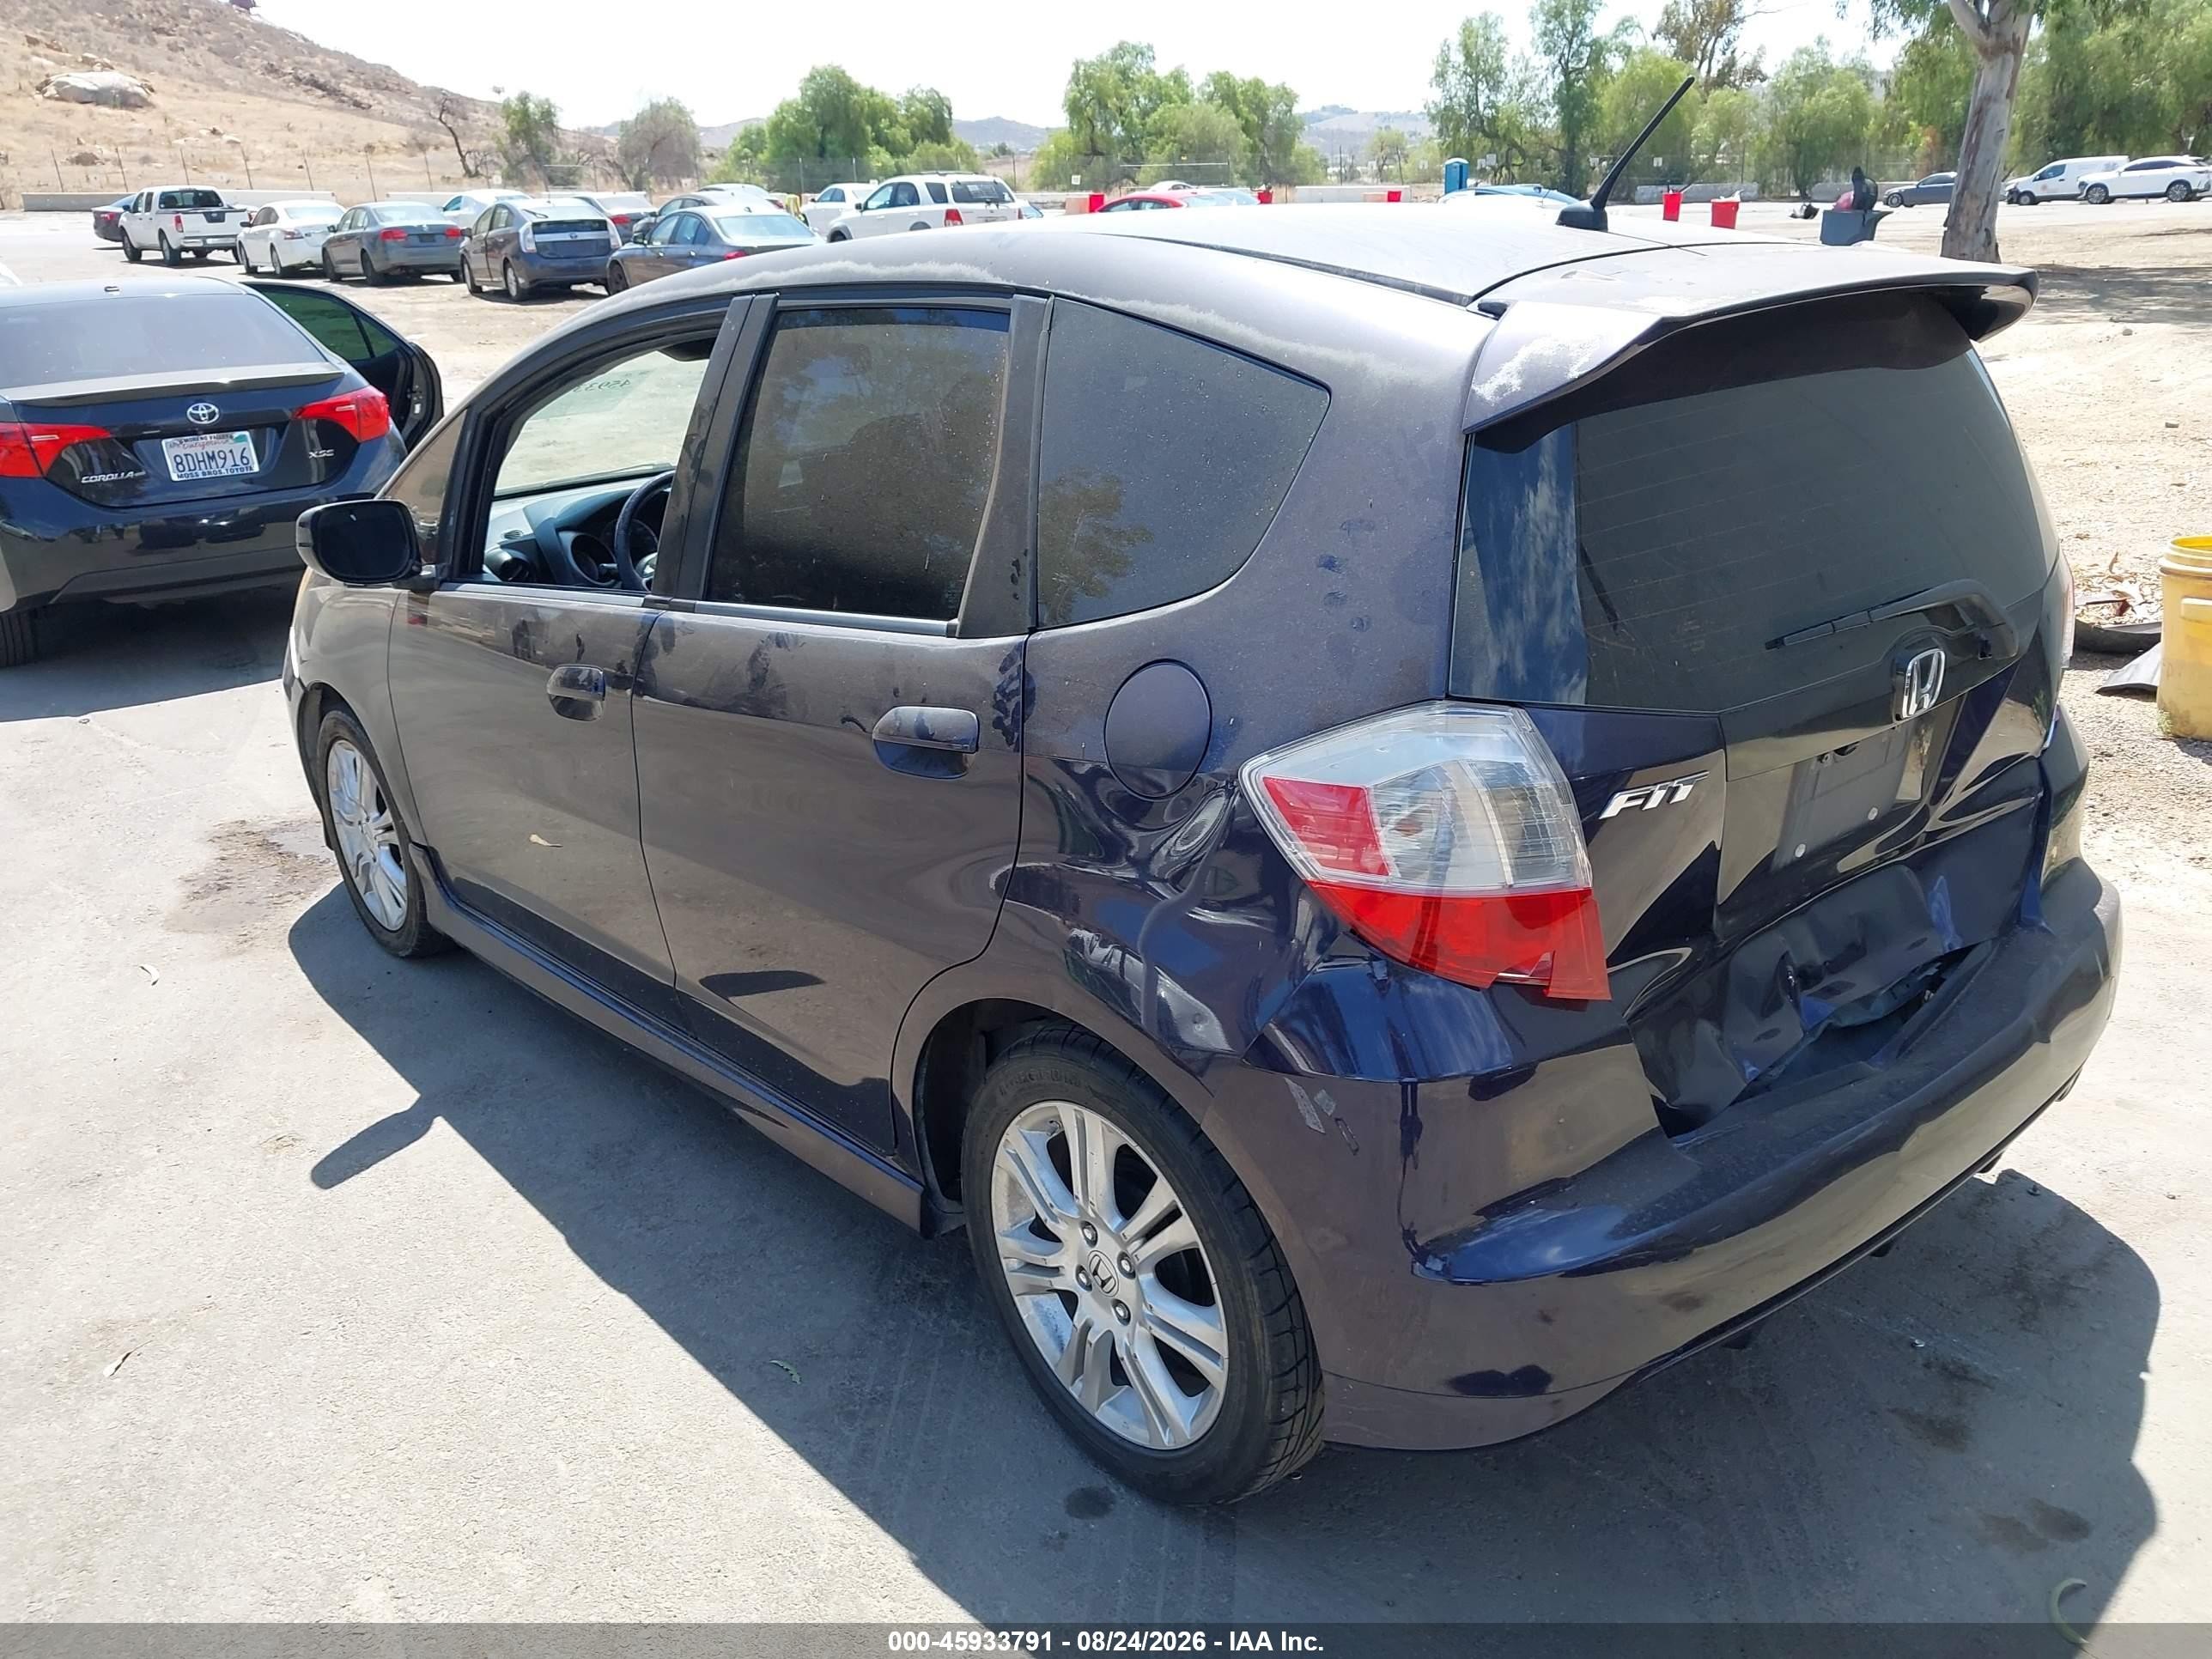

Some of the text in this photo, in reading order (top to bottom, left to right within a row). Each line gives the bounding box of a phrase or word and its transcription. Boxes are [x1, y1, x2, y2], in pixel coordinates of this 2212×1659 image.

[173, 447, 250, 473] 8DHM916
[81, 471, 134, 483] COROLLA
[1599, 771, 1710, 819] FIT
